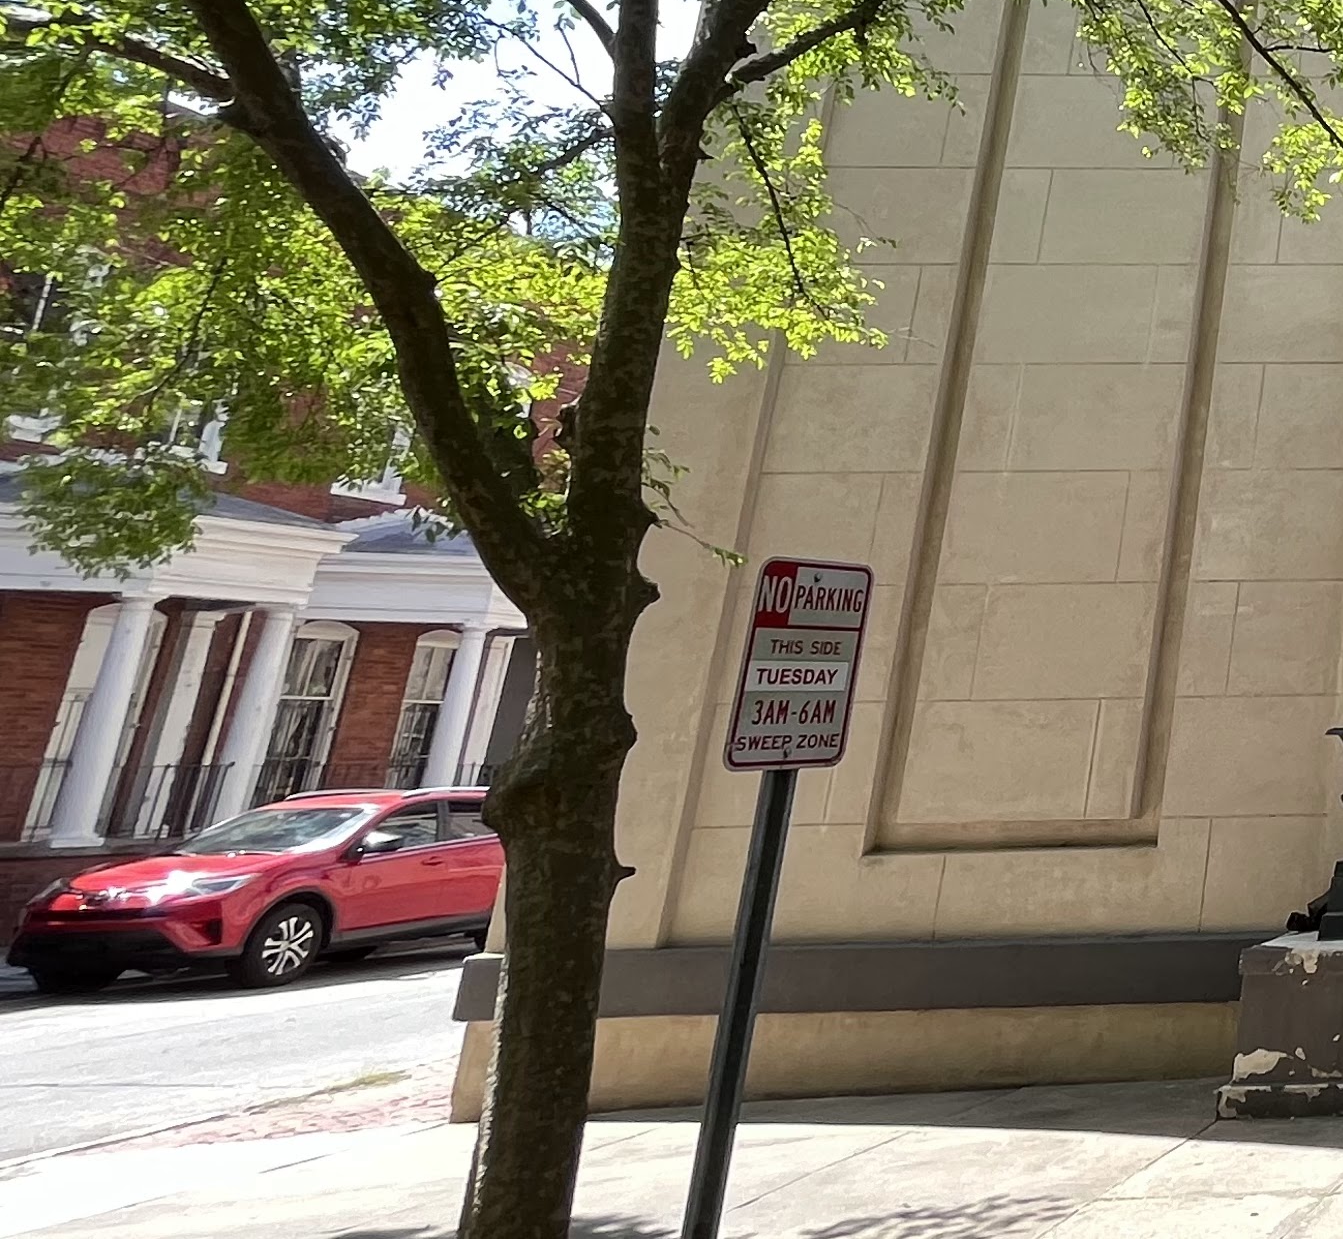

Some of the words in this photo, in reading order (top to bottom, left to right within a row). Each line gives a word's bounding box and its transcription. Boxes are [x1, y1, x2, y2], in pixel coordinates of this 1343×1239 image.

[757, 575, 792, 613] NO
[794, 584, 864, 613] PARKING
[770, 638, 803, 655] THIS
[810, 641, 842, 655] SIDE
[756, 668, 838, 685] TUESDAY
[751, 699, 836, 725] 3AM-6AM
[735, 735, 792, 751] SWEEP
[796, 733, 839, 749] ZONE
